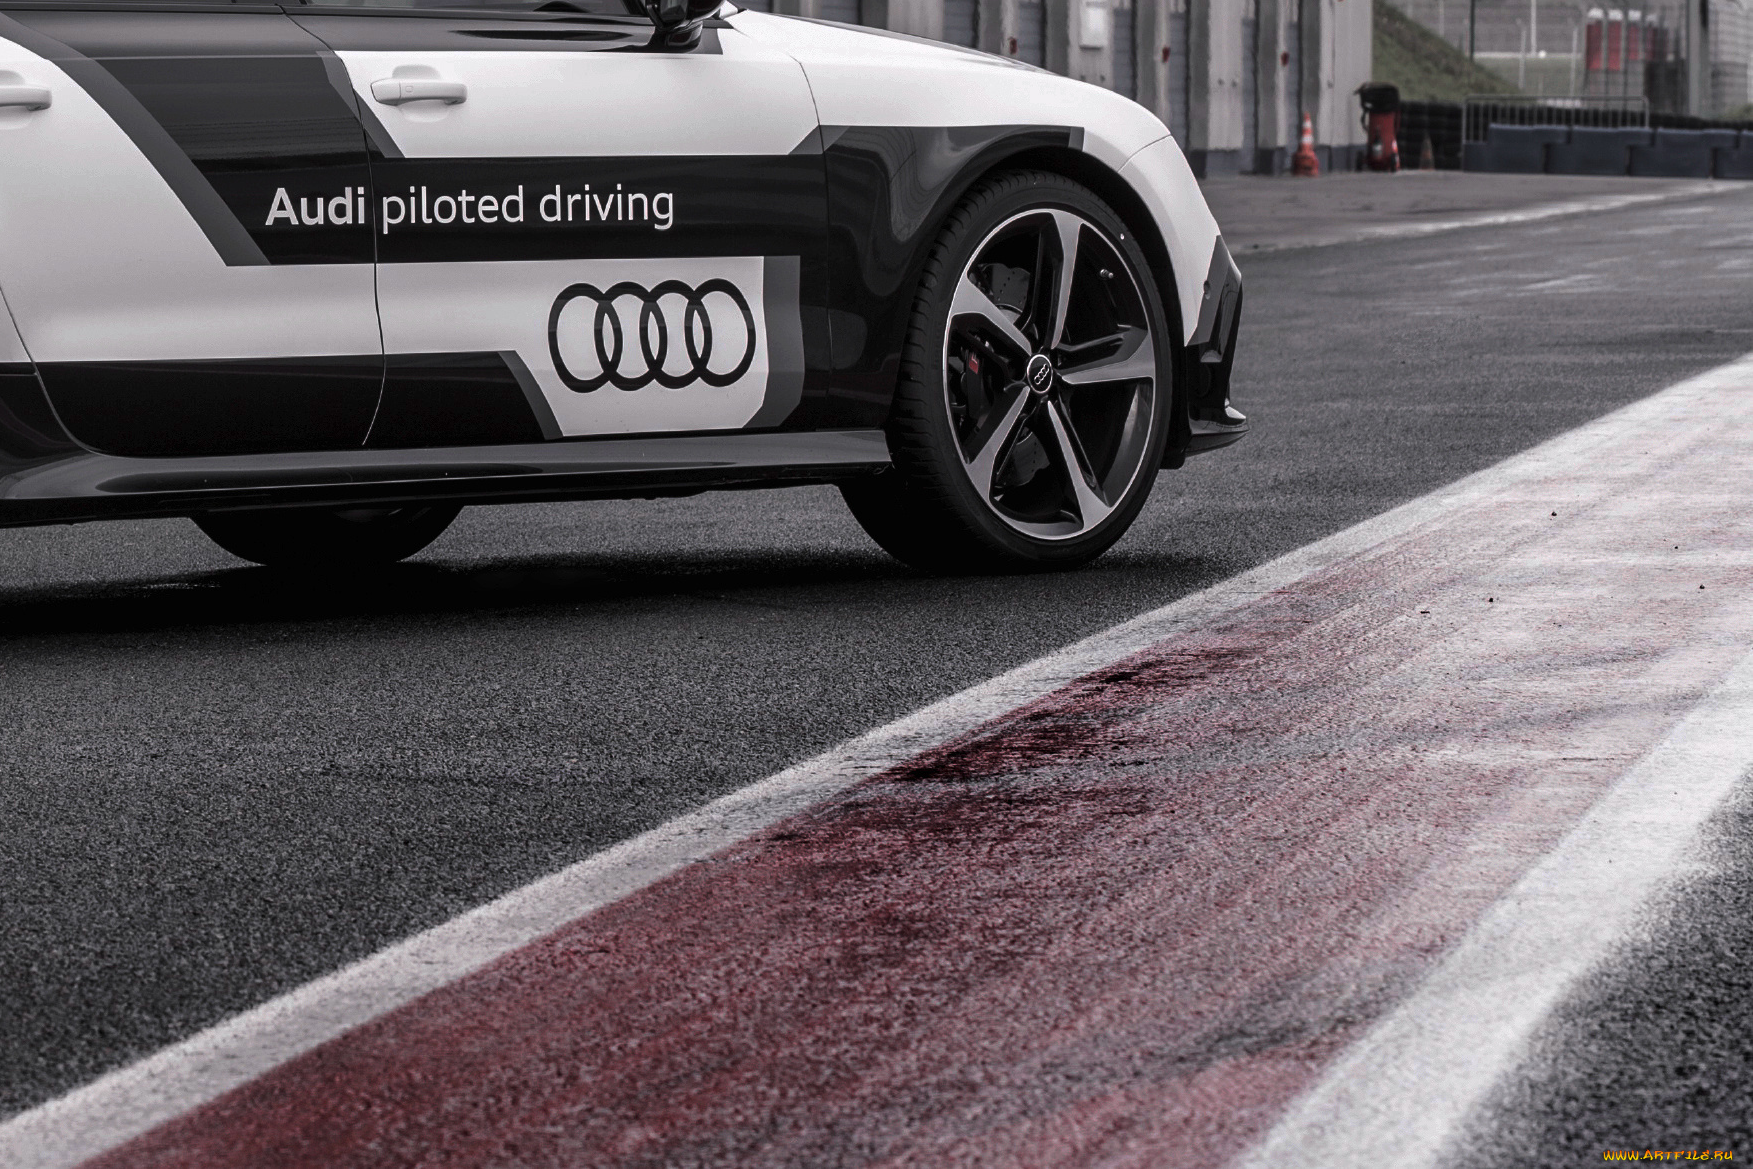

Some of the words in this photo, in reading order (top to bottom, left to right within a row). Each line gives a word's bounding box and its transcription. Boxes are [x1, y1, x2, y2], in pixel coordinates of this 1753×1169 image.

[265, 187, 365, 226] Audi
[382, 185, 524, 234] piloted
[540, 184, 674, 230] driving
